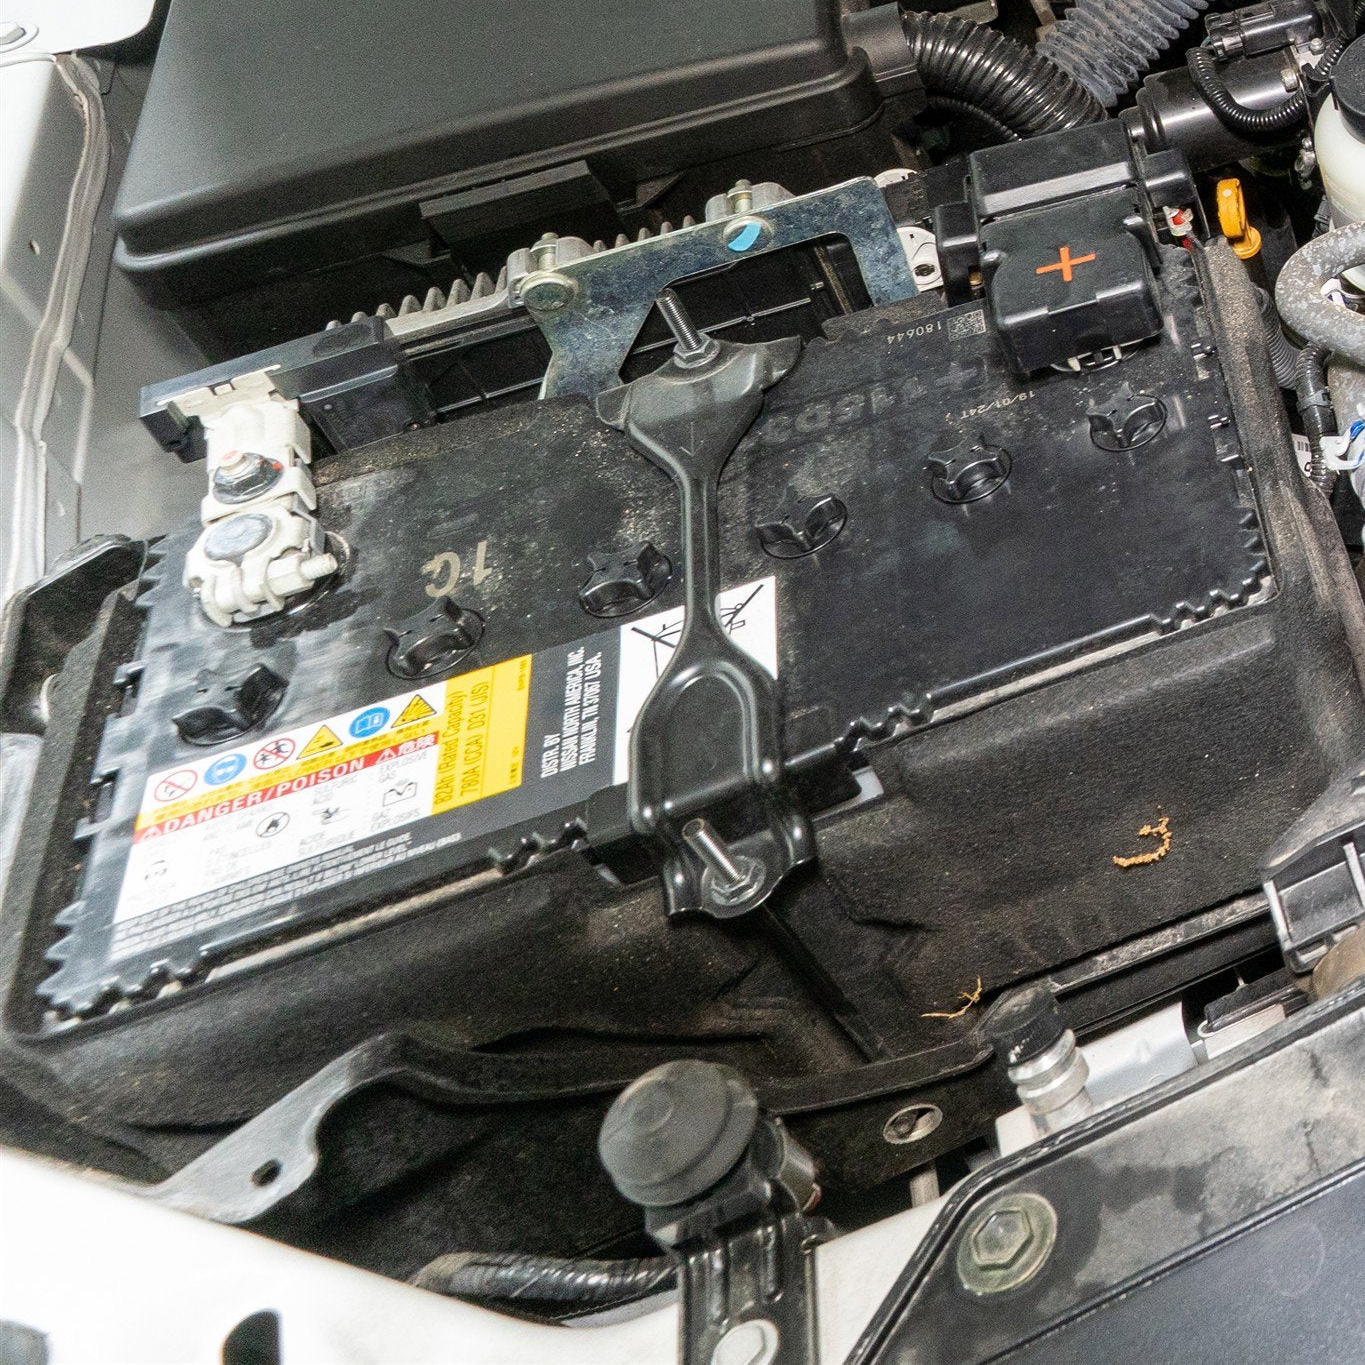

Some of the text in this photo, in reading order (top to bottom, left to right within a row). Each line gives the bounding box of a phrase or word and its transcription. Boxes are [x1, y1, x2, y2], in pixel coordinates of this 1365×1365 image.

[886, 320, 941, 344] 180644
[585, 651, 602, 680] USA.
[563, 705, 580, 738] NORTH
[581, 704, 598, 721] TN
[434, 690, 467, 804] 82Ah (Rated Capacity)
[460, 681, 489, 797] 780A (CCA) D31 (JIS)
[541, 733, 561, 778] DISTR. BY
[560, 735, 579, 772] NISSAN
[164, 756, 366, 833] DANGER/POISON
